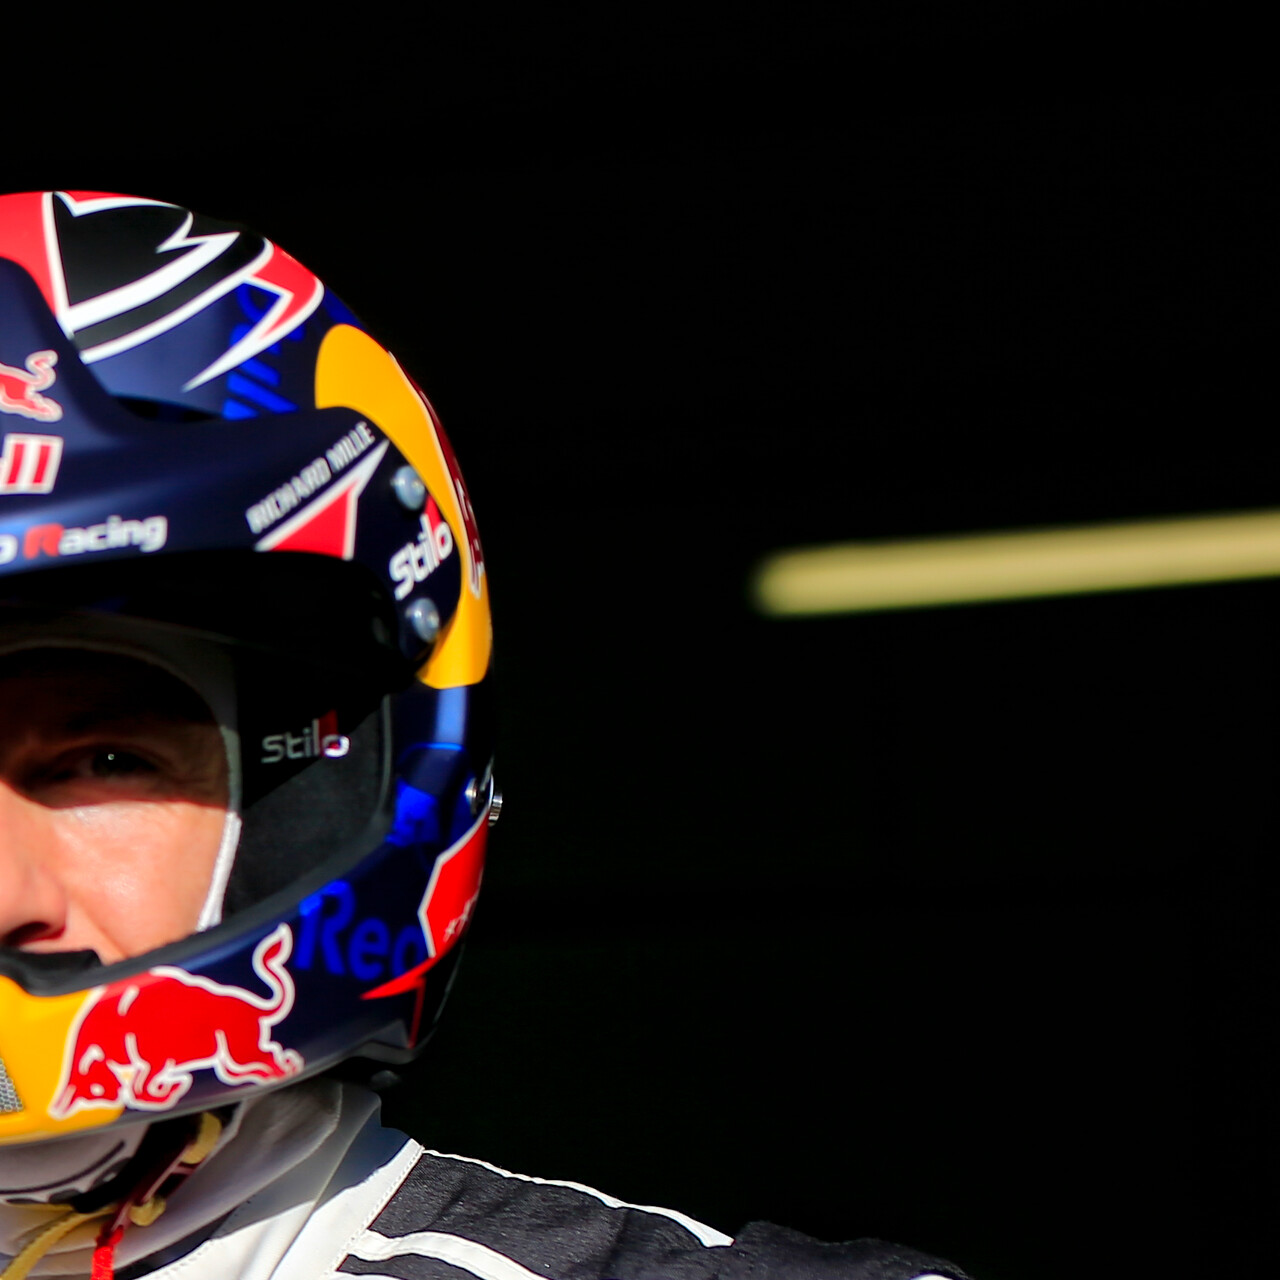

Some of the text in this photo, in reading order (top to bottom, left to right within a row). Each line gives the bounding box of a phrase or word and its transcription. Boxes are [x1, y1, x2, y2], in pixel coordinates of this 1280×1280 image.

[245, 421, 376, 535] RICHARD MILLE
[23, 515, 168, 560] Racing
[389, 513, 454, 601] Stilo
[261, 717, 350, 765] Stilo
